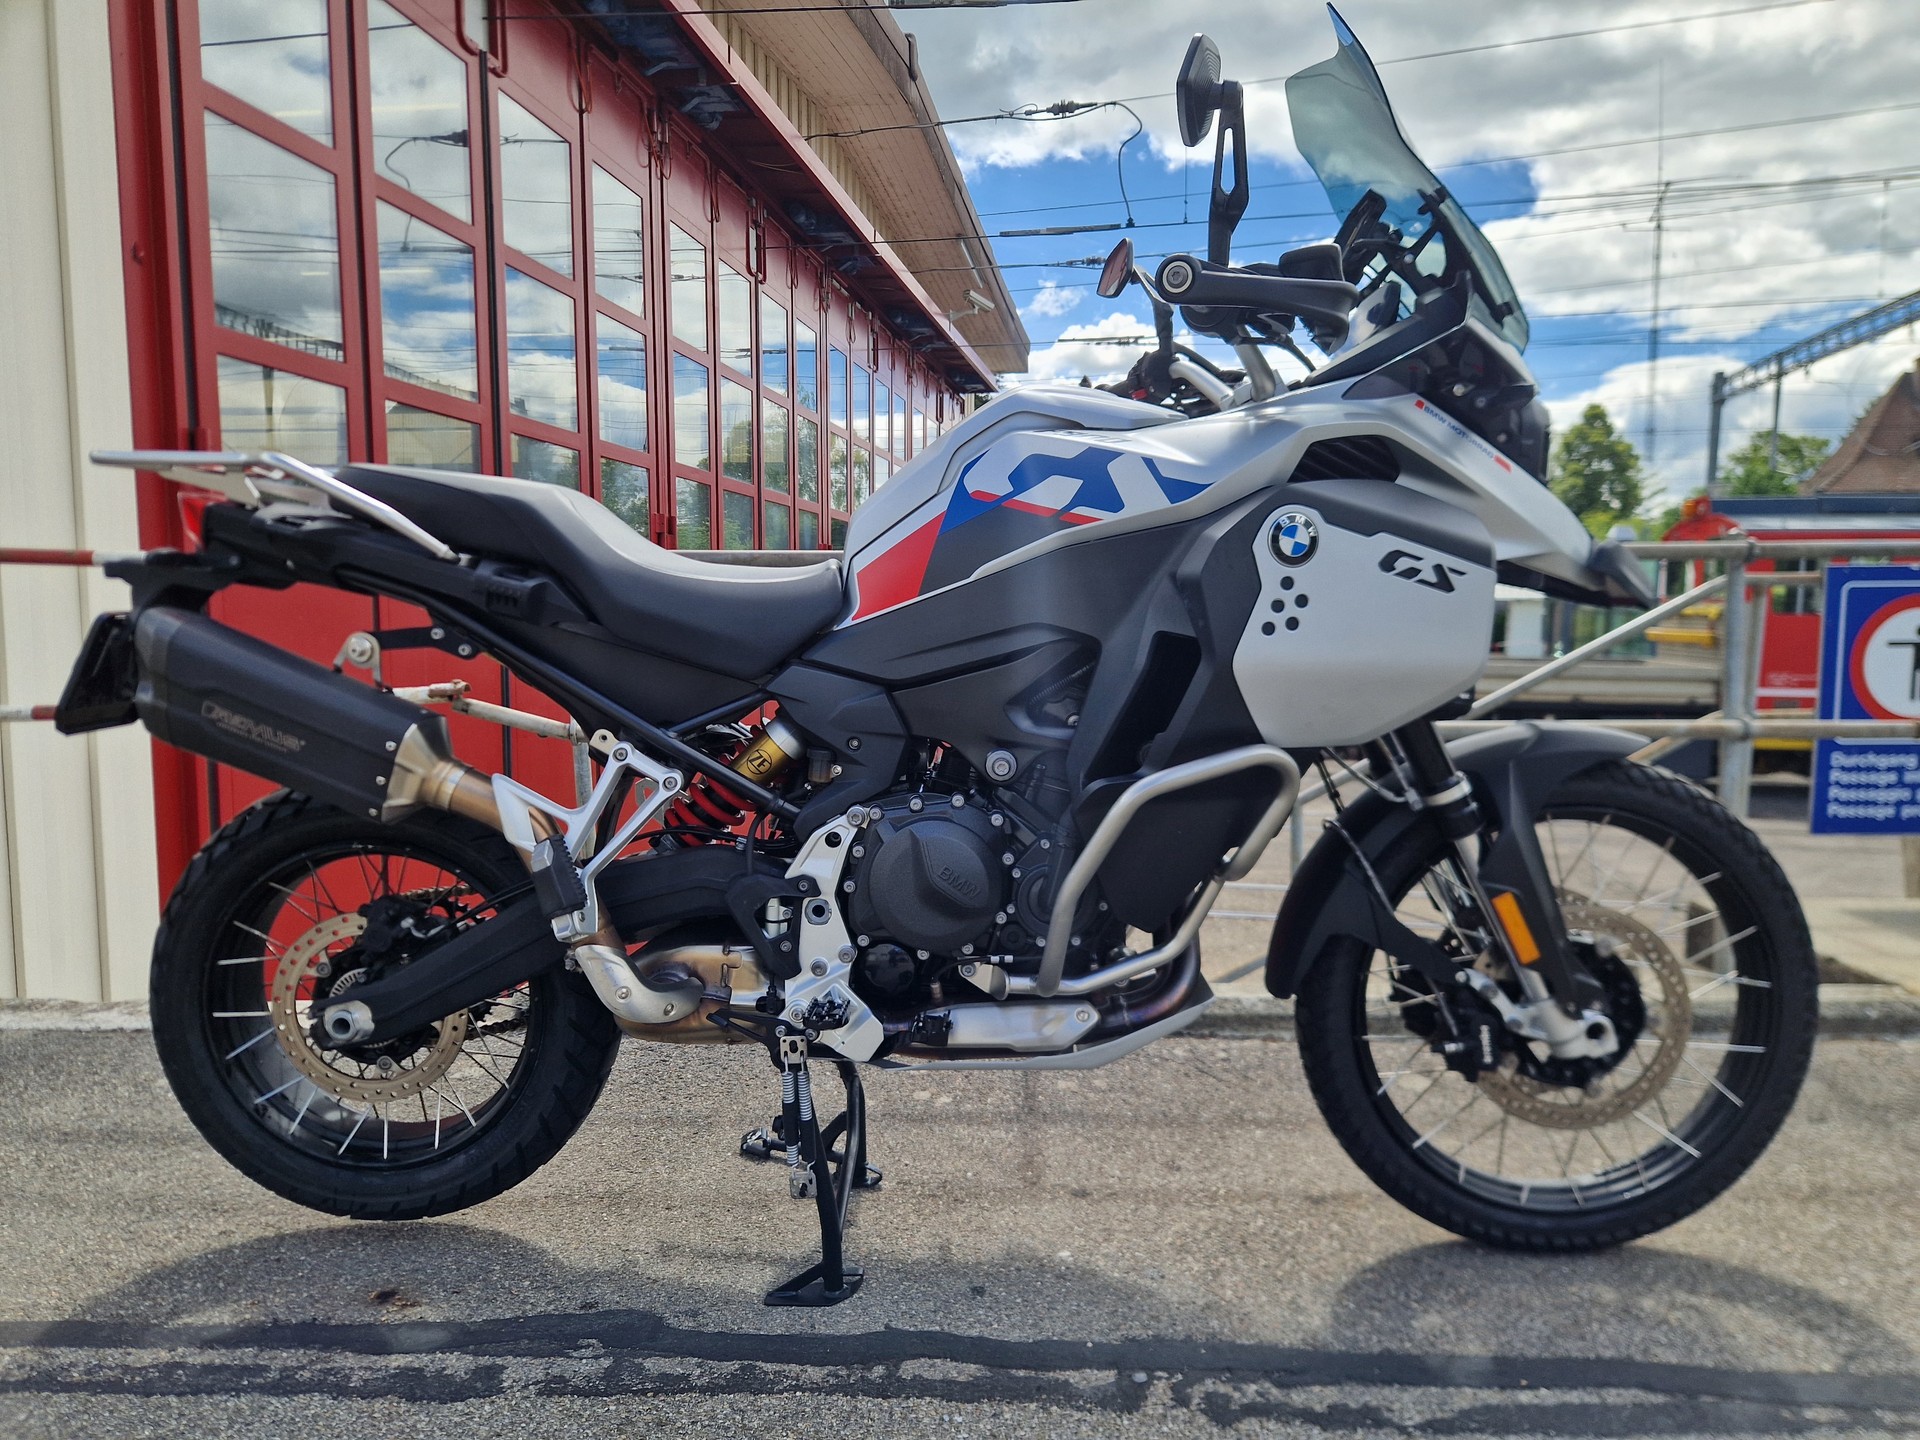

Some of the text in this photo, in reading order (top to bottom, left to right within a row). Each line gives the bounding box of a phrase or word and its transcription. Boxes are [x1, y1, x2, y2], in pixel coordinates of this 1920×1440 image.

[1424, 405, 1447, 425] BMW
[1279, 515, 1317, 538] BMW
[1378, 549, 1467, 594] GS
[938, 866, 981, 897] BMW
